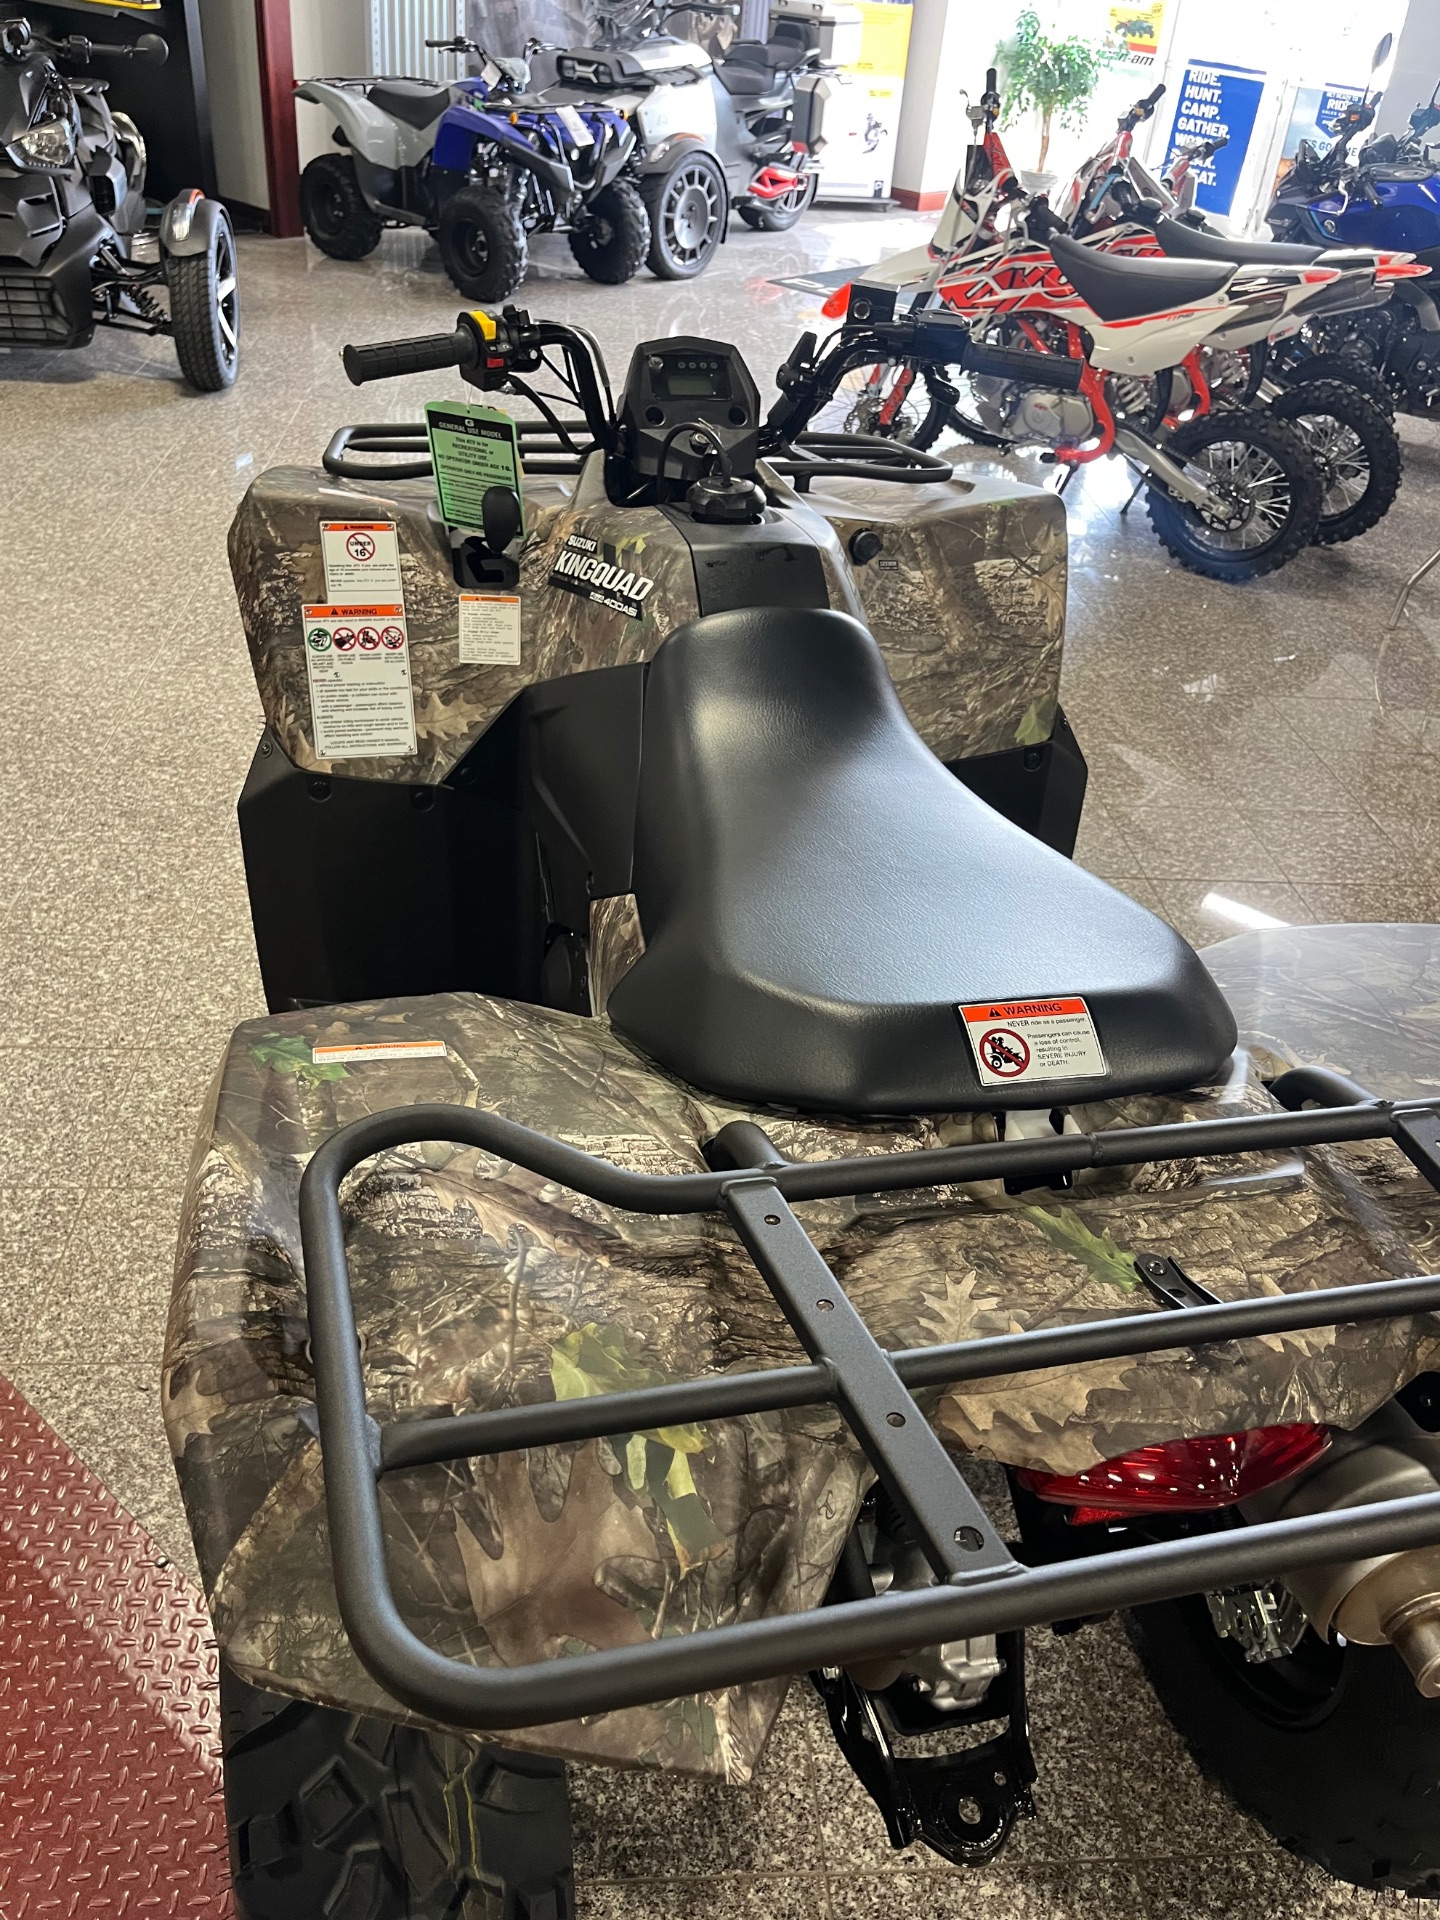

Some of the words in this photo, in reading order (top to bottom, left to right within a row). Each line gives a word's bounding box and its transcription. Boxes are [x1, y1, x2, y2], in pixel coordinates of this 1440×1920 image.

[1188, 69, 1222, 87] RIDE.
[1184, 85, 1223, 104] HUNT.
[1181, 101, 1220, 121] CAMP.
[1177, 117, 1231, 140] GATHER.
[438, 422, 466, 432] GENERAL
[467, 427, 479, 435] USE
[481, 429, 503, 439] MODEL
[568, 535, 597, 552] SUZUKI
[354, 548, 366, 557] 16
[554, 550, 654, 601] KINGQUAD
[341, 608, 378, 616] WARNING
[1003, 1003, 1062, 1016] WARNING
[1007, 1020, 1030, 1028] NEVER
[1027, 1032, 1061, 1040] Passengers
[1036, 1045, 1062, 1053] resulting
